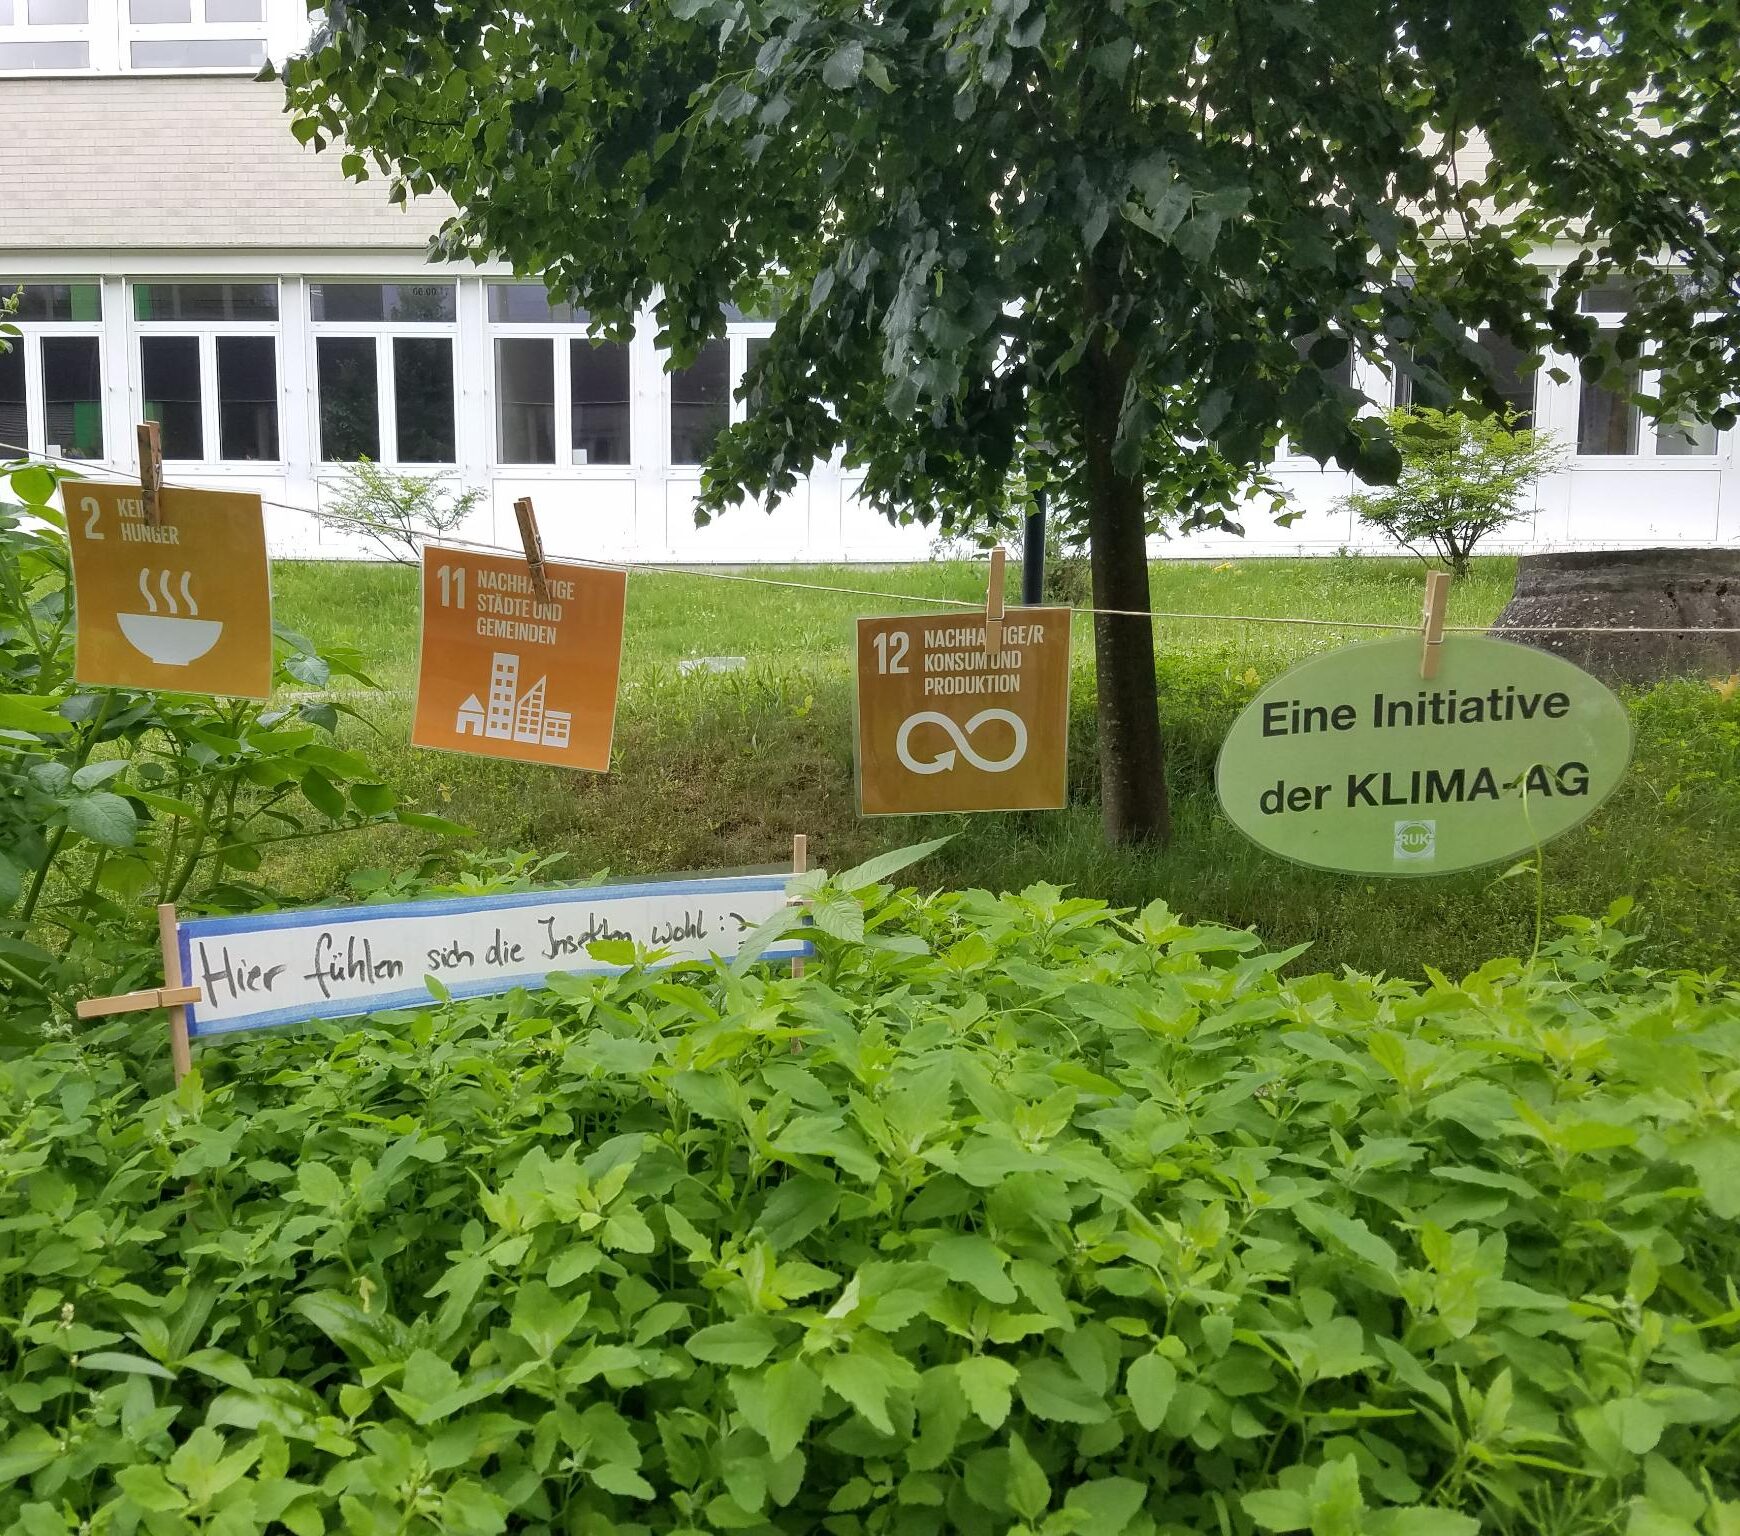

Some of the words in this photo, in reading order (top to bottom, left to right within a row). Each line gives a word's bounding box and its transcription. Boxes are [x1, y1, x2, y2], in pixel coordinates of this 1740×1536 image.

[80, 497, 104, 540] 2
[121, 522, 180, 544] HUNGER
[437, 565, 466, 609] 11
[477, 569, 576, 600] NACHHATIGE
[477, 593, 531, 618] STÄDTE
[532, 600, 562, 622] UND
[476, 616, 557, 645] GEMEINDEN
[924, 625, 1044, 648] NACHHAIGE/R
[873, 631, 910, 675] 12
[924, 651, 987, 673] KONSUM
[990, 650, 1022, 670] UND
[924, 674, 1020, 696] PRODUKTION
[1262, 702, 1356, 737] Eine
[1373, 686, 1570, 729] Initiative
[1260, 780, 1332, 815] der
[1347, 761, 1590, 808] KLIMA-AG
[200, 942, 288, 1009] Hier
[304, 932, 404, 999] fühlen
[427, 940, 475, 971] sich
[485, 928, 525, 967] die
[651, 909, 708, 945] wohl
